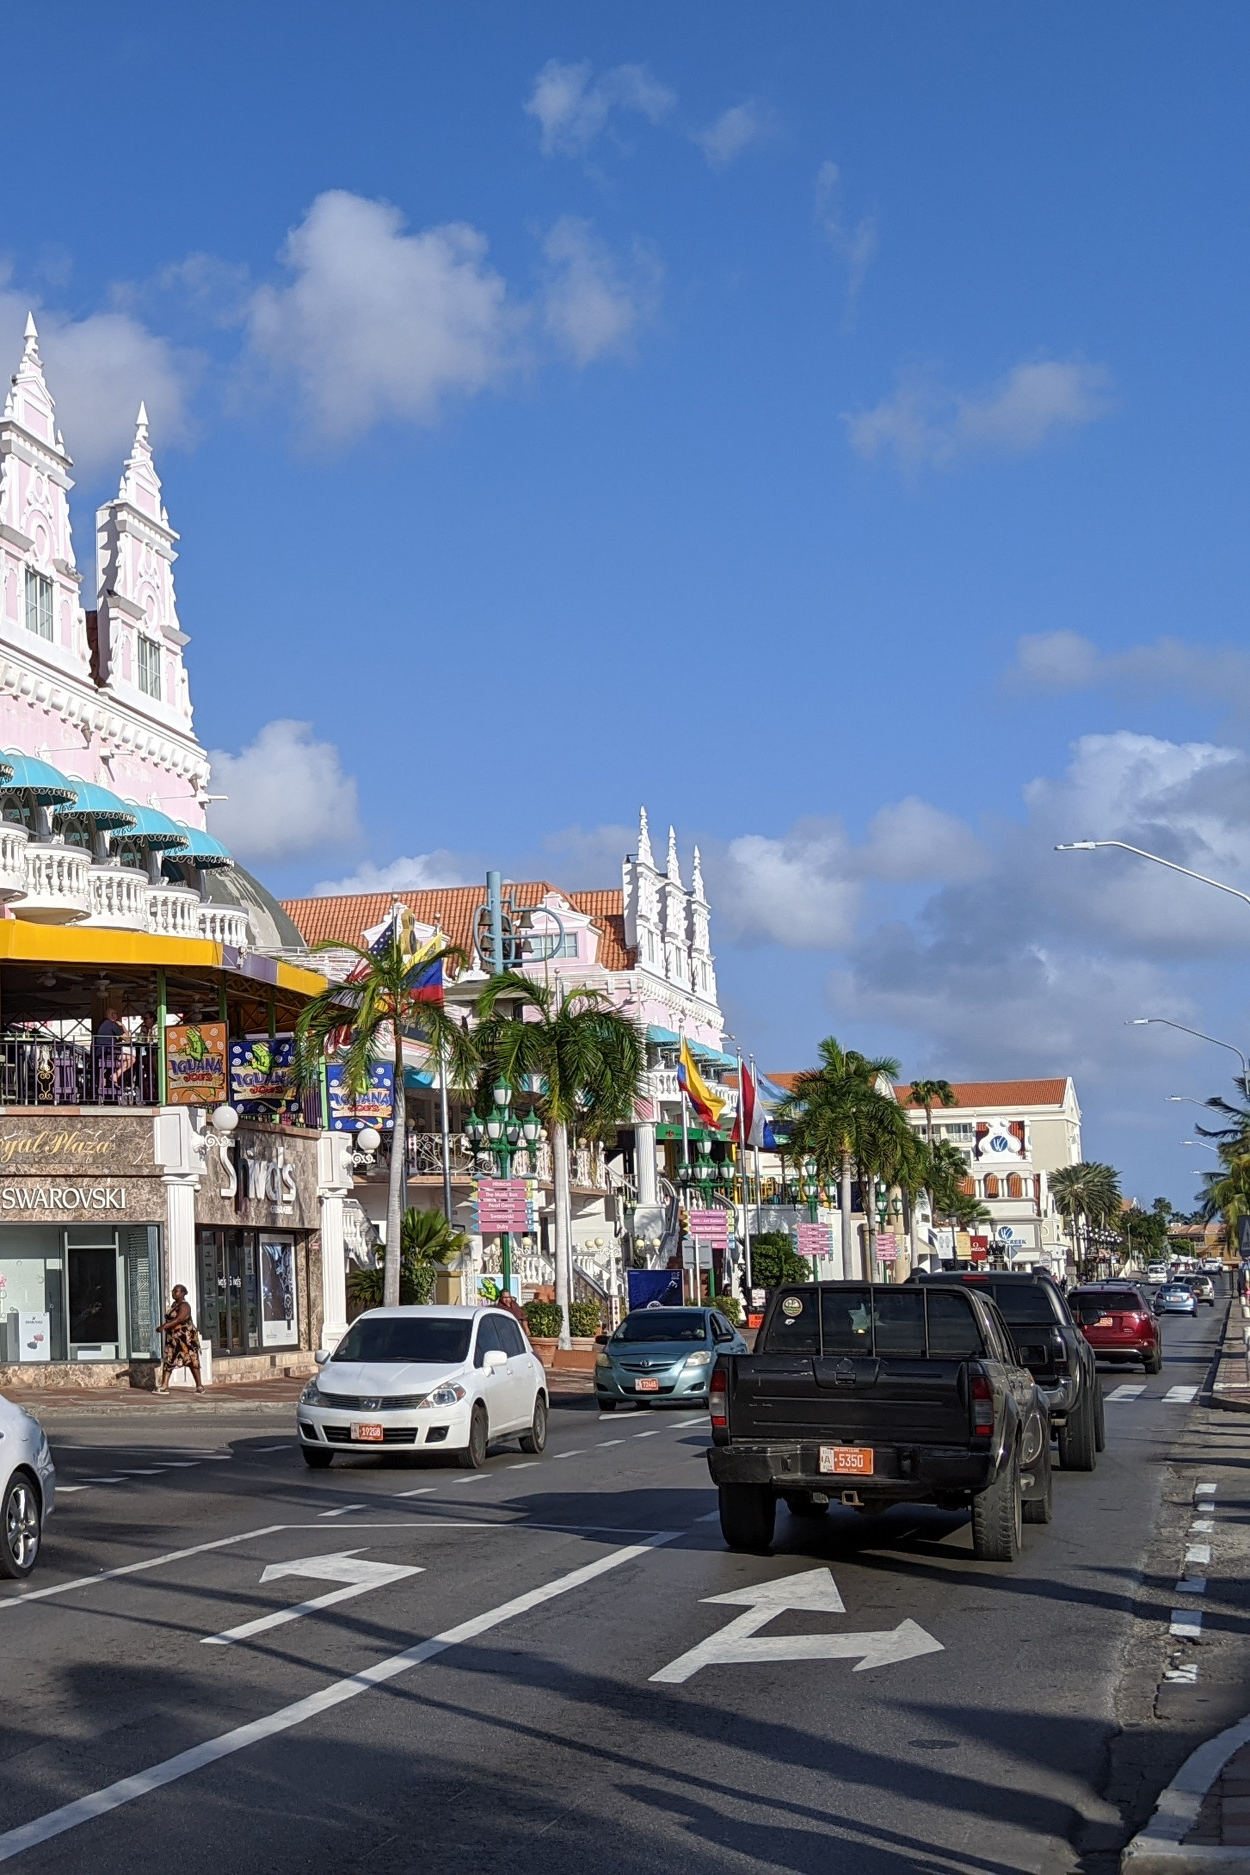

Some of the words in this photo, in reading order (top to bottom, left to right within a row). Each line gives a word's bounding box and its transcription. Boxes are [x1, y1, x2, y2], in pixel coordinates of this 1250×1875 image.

[169, 1057, 223, 1075] IGUANA
[330, 1092, 390, 1106] IGANA
[44, 1130, 111, 1155] Plaza
[2, 1187, 126, 1209] SWAROVSKI
[838, 1453, 864, 1468] 5350
